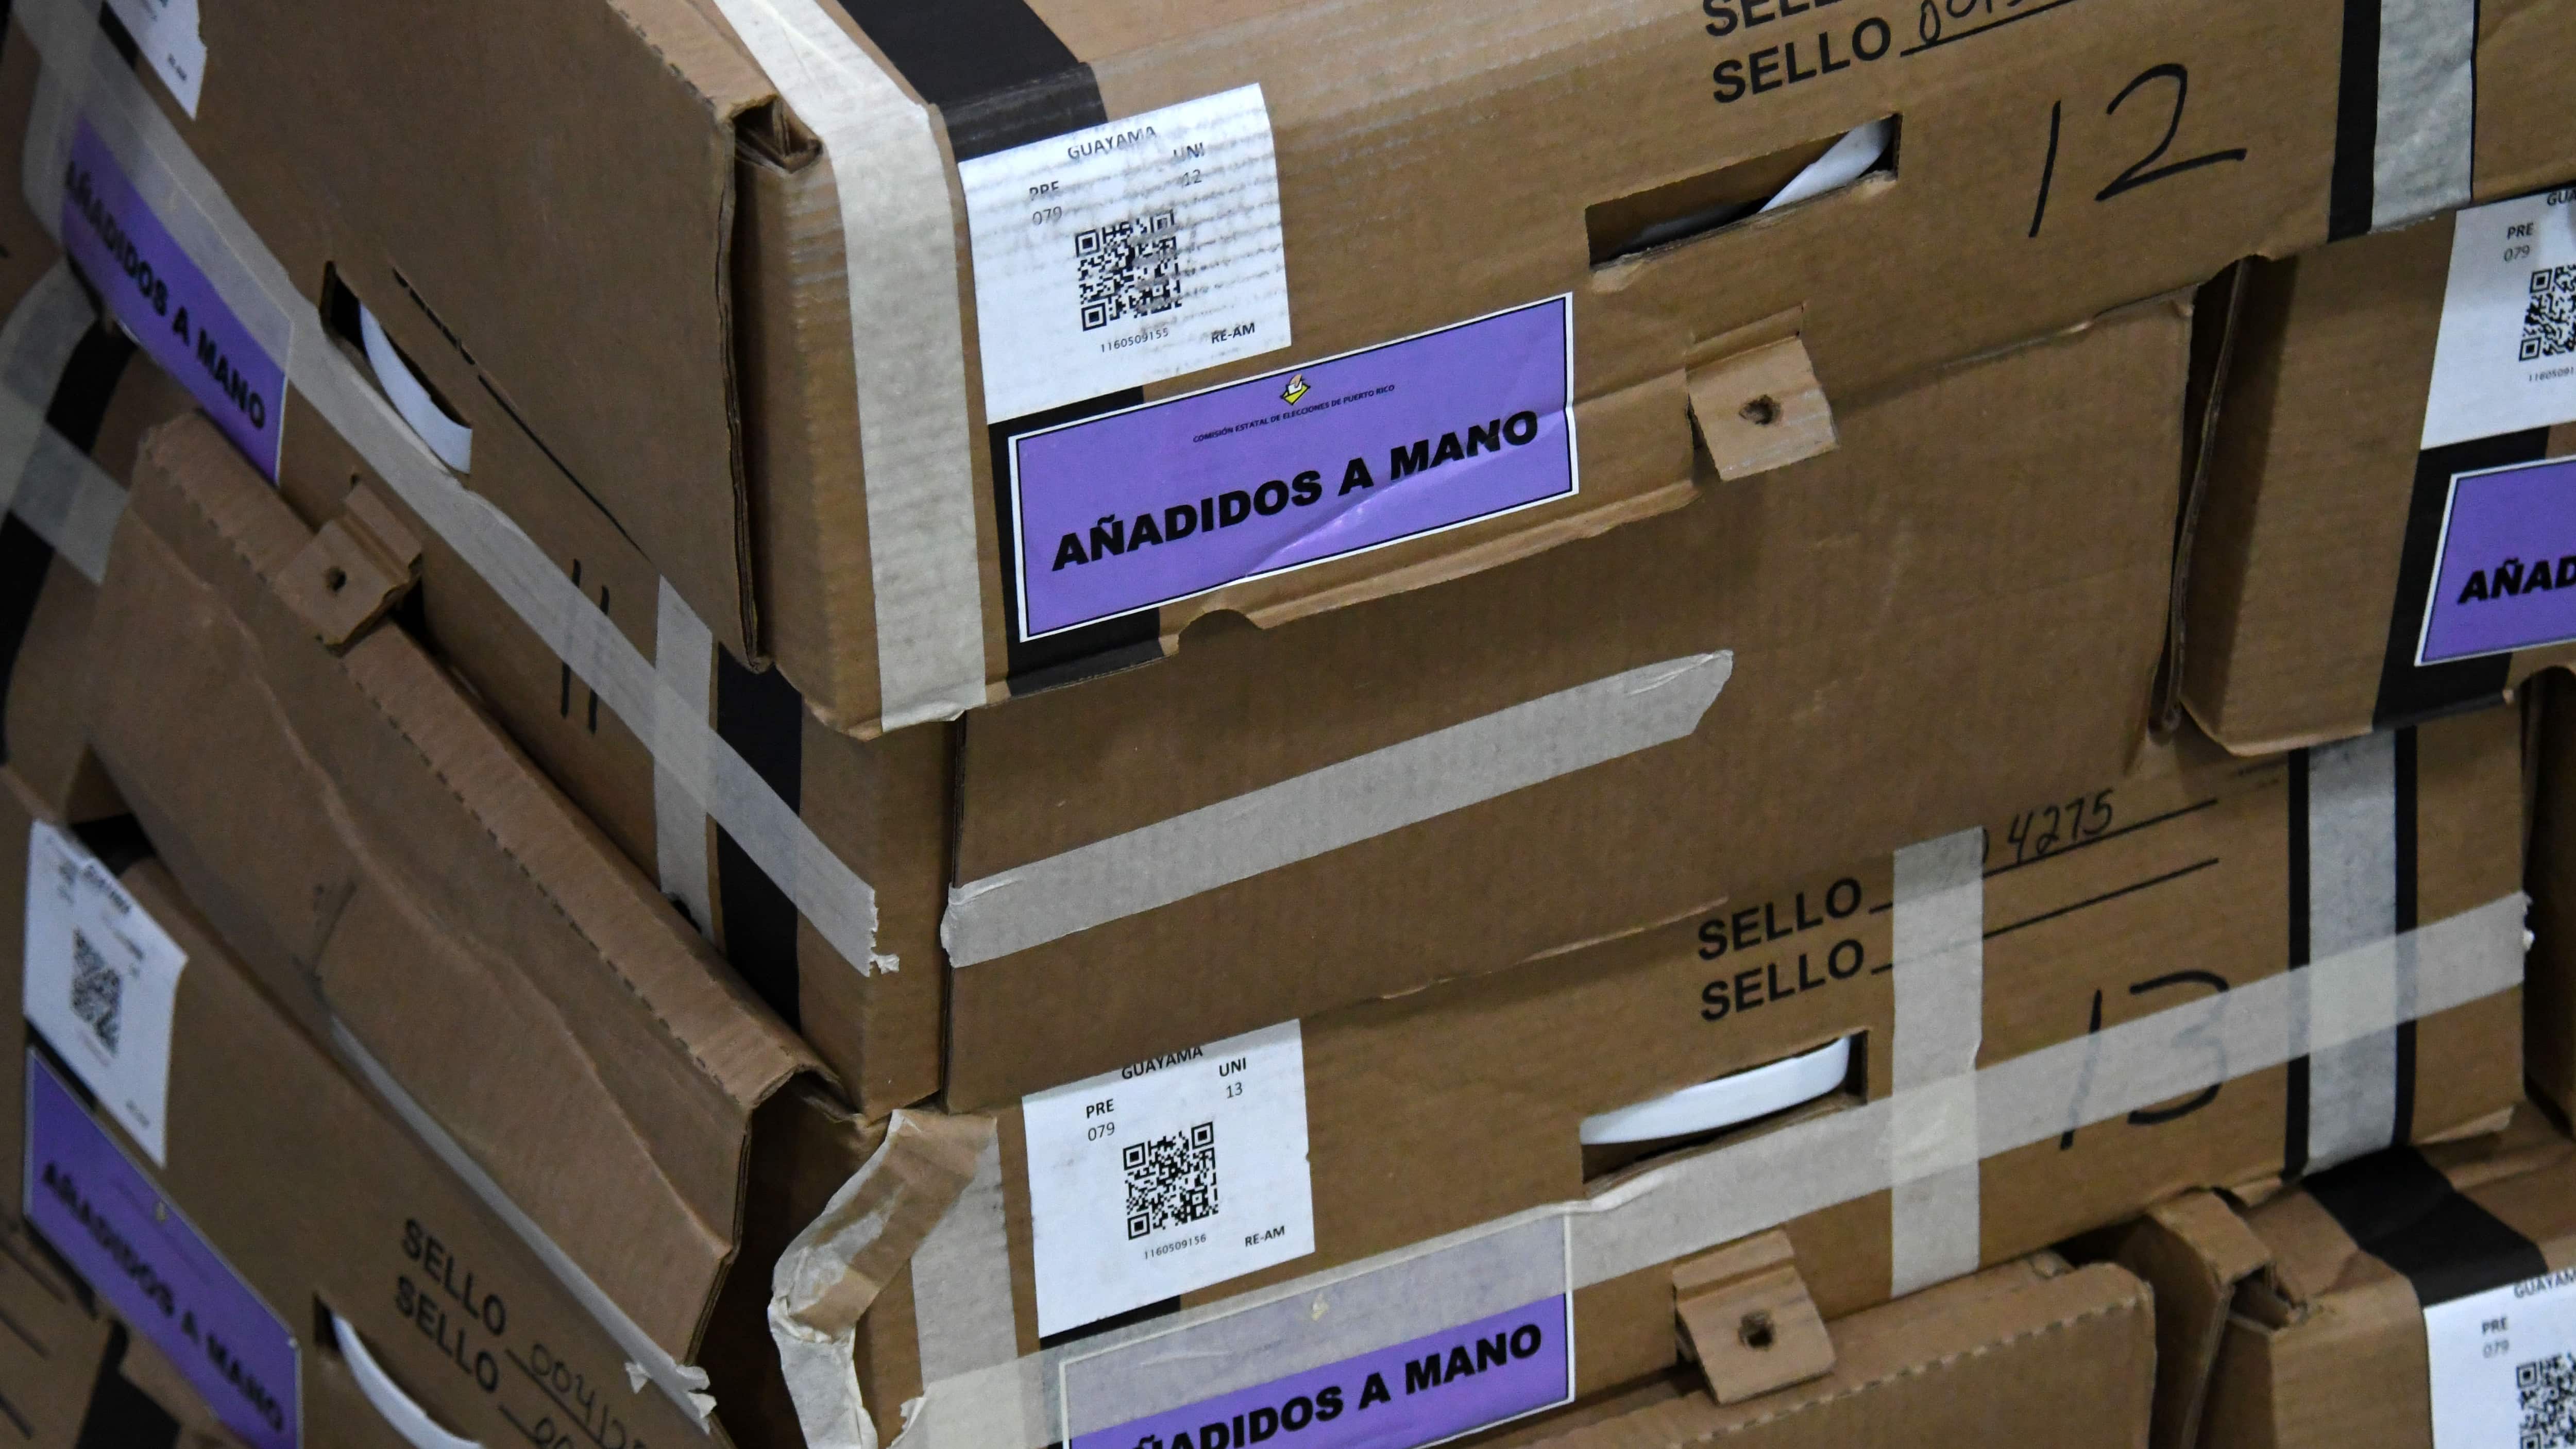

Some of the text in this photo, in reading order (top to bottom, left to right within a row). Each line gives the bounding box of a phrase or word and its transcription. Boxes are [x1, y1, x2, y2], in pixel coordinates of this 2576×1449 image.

[1713, 17, 1891, 103] SELLO
[1067, 125, 1157, 160] GUAYAMA
[1173, 142, 1205, 160] UNI
[2029, 62, 2247, 238] 12
[1182, 168, 1202, 187] 12
[1032, 206, 1062, 226] 079
[2506, 222, 2534, 240] PRE
[2504, 244, 2530, 262] 079
[1101, 328, 1169, 353] 1160509155
[1211, 322, 1256, 344] RE-AM
[172, 306, 191, 347] A
[198, 329, 266, 430] MANO
[1193, 384, 1395, 443] COMISIÓN ESTATAL DE ELECCIONES DE PUERTO RICO
[1052, 410, 1539, 571] AÑADIDOS A MANO
[1983, 788, 2113, 864] 4275
[1698, 877, 1862, 961] SELLO
[1701, 939, 1865, 1022] SELLO
[1122, 1046, 1204, 1081] GUAYAMA
[1218, 1058, 1247, 1078] UNI
[2060, 969, 2230, 1151] 13
[1226, 1081, 1243, 1099] 13
[1086, 1099, 1114, 1119] PRE
[1088, 1122, 1115, 1141] 079
[1144, 1234, 1207, 1260] 1160509156
[1245, 1225, 1285, 1247] RE-AM
[401, 1218, 506, 1335] SELLO
[395, 1275, 499, 1393] SELLO
[2481, 1316, 2507, 1335] PRE
[2483, 1340, 2510, 1359] 079
[1359, 1372, 1391, 1410] A
[1405, 1323, 1541, 1394] MANO
